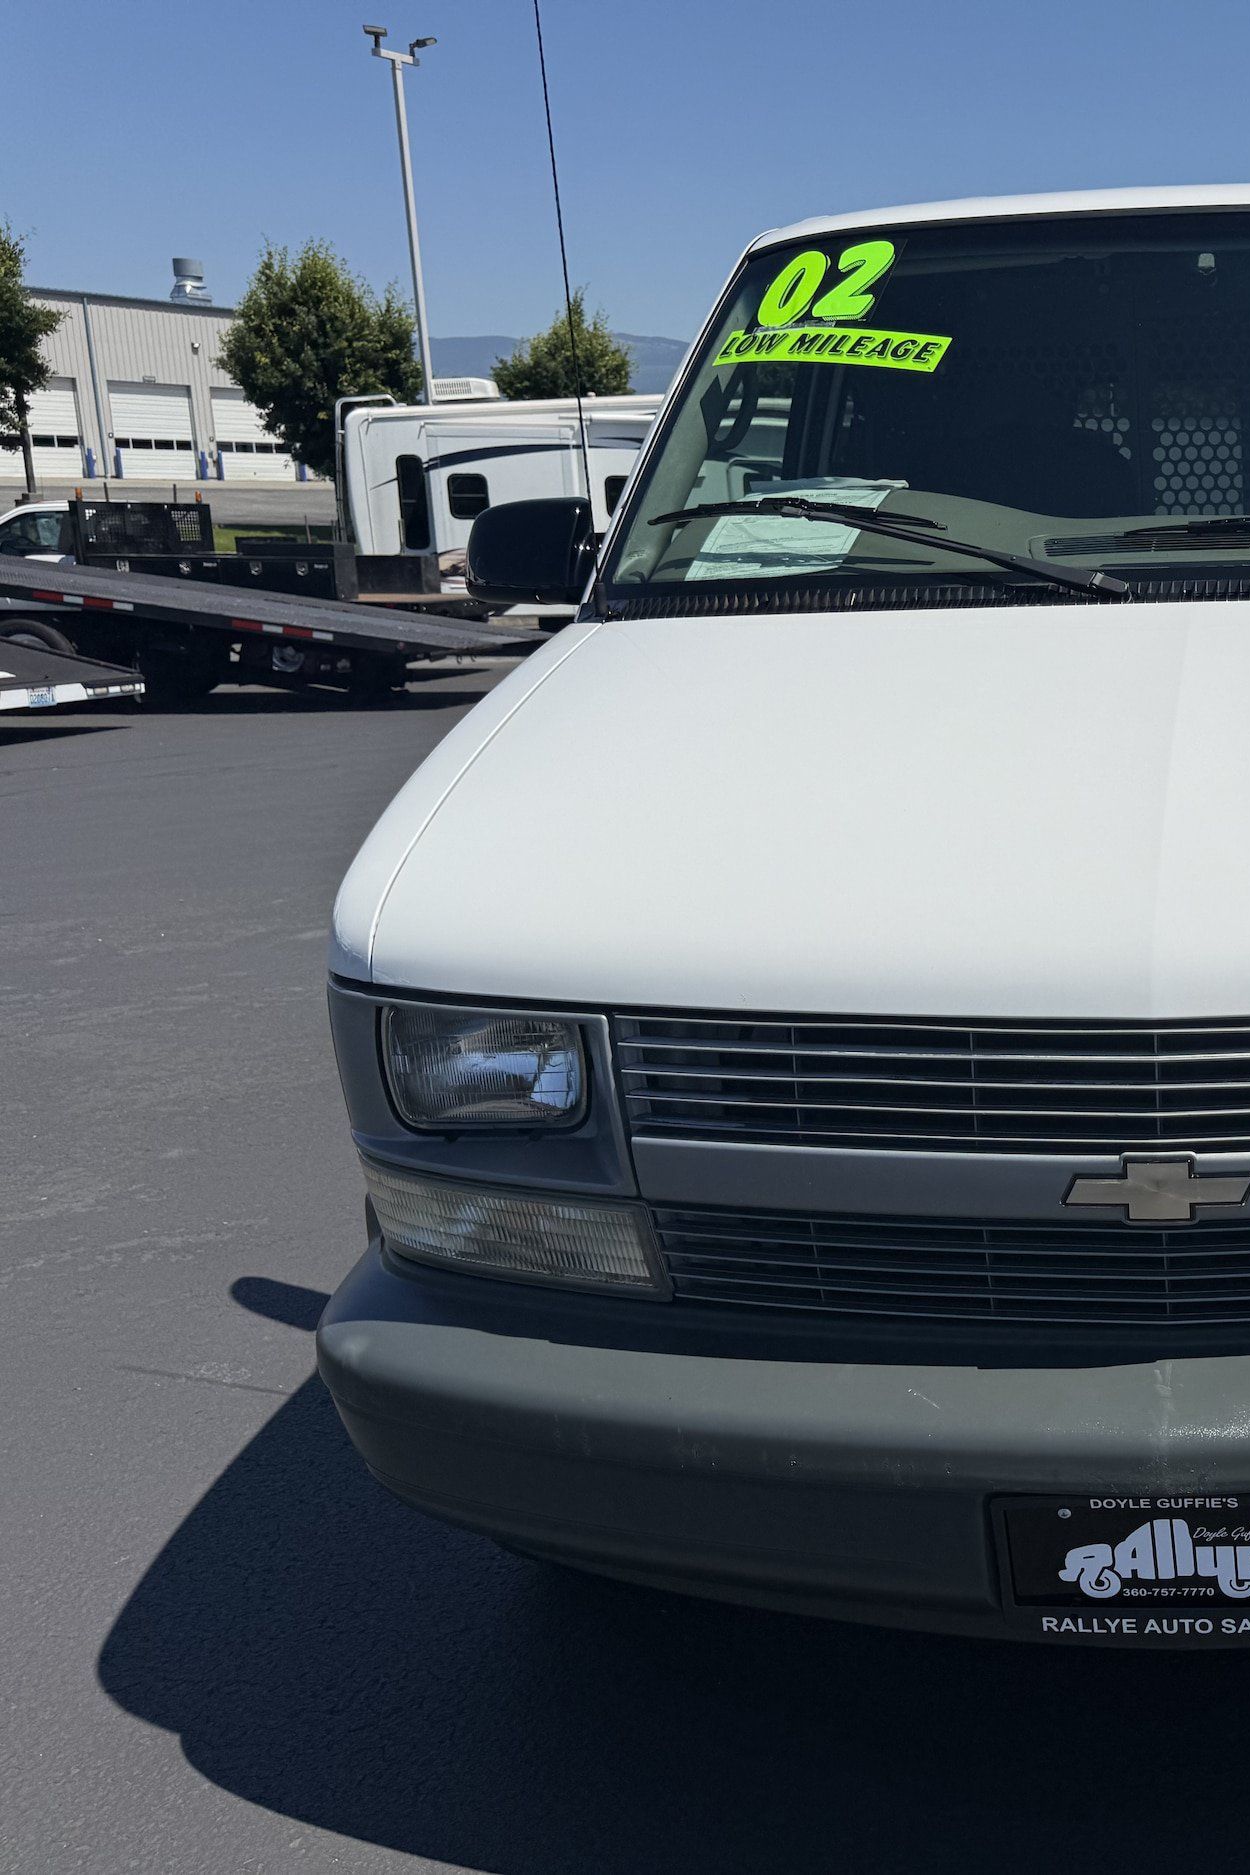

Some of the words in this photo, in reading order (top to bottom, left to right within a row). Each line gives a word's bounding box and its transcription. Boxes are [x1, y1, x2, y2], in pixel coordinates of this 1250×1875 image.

[757, 240, 895, 327] 02
[719, 333, 788, 358] LOW
[788, 334, 942, 362] MILEAGE
[1089, 1498, 1151, 1509] DOYLE
[1156, 1497, 1239, 1509] GUFFIE'S
[1192, 1526, 1228, 1542] Doyle
[1122, 1587, 1215, 1597] 360-757-7770
[1041, 1616, 1138, 1634] RALLYE
[1143, 1617, 1214, 1634] AUTO
